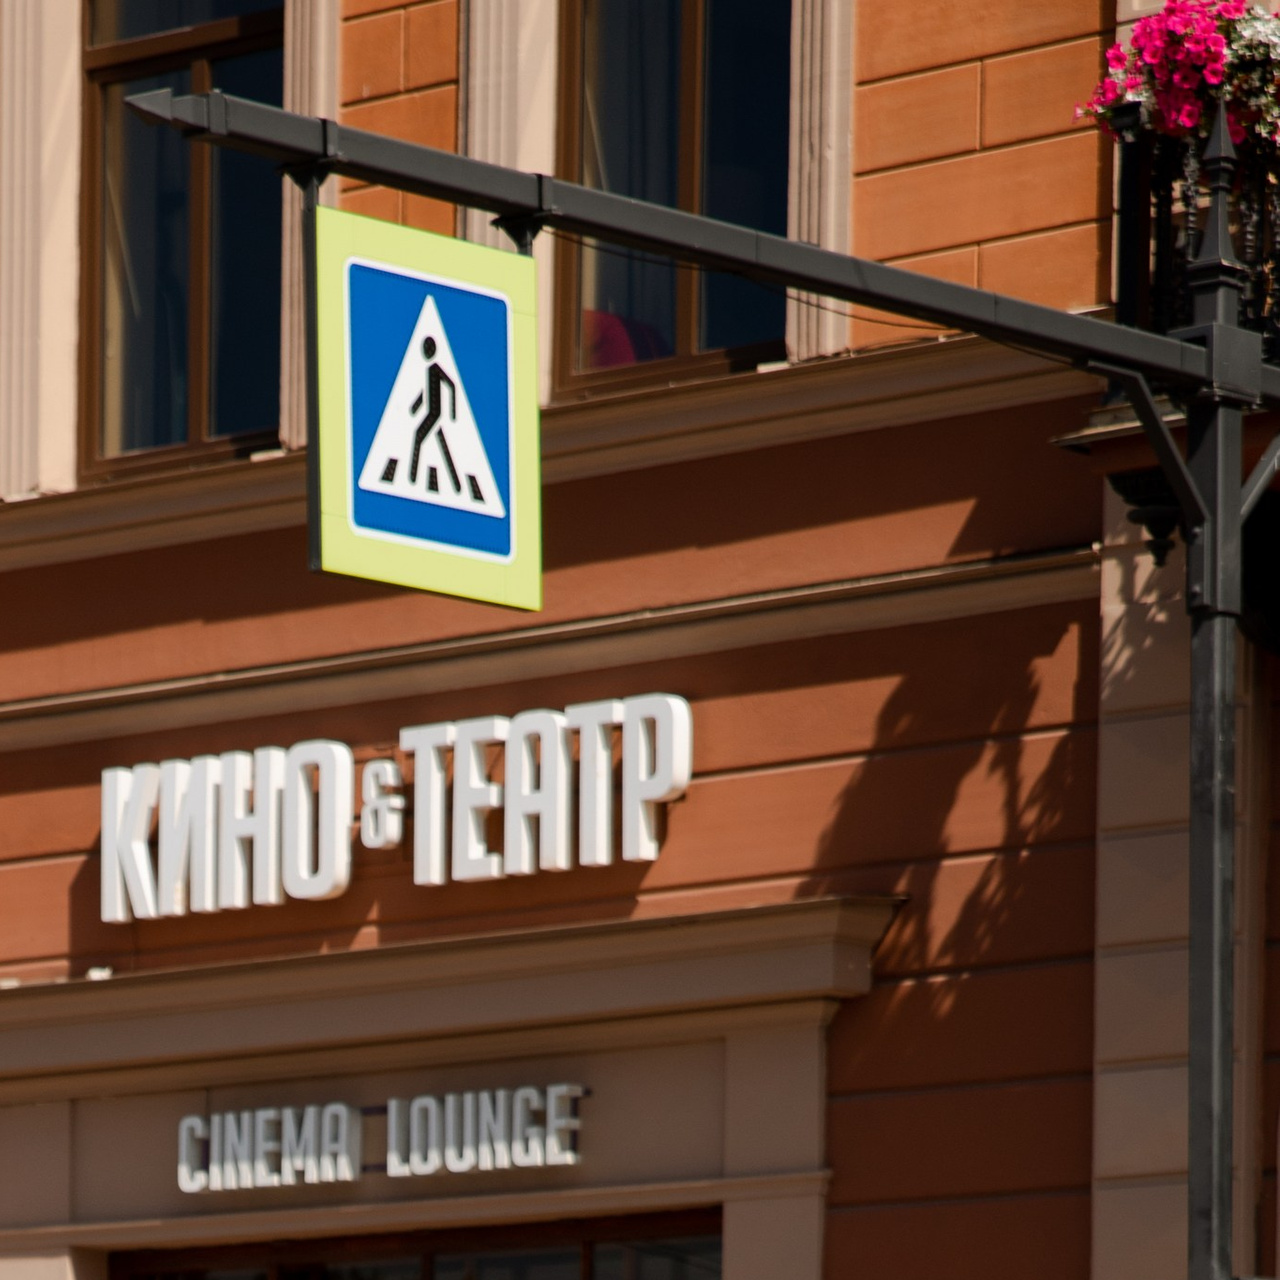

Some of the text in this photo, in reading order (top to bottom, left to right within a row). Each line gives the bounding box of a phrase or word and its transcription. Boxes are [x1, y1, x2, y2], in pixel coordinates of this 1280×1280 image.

[101, 692, 693, 924] КИНО & ТЕАТР
[177, 1083, 583, 1193] CINEMA LOUNGE
